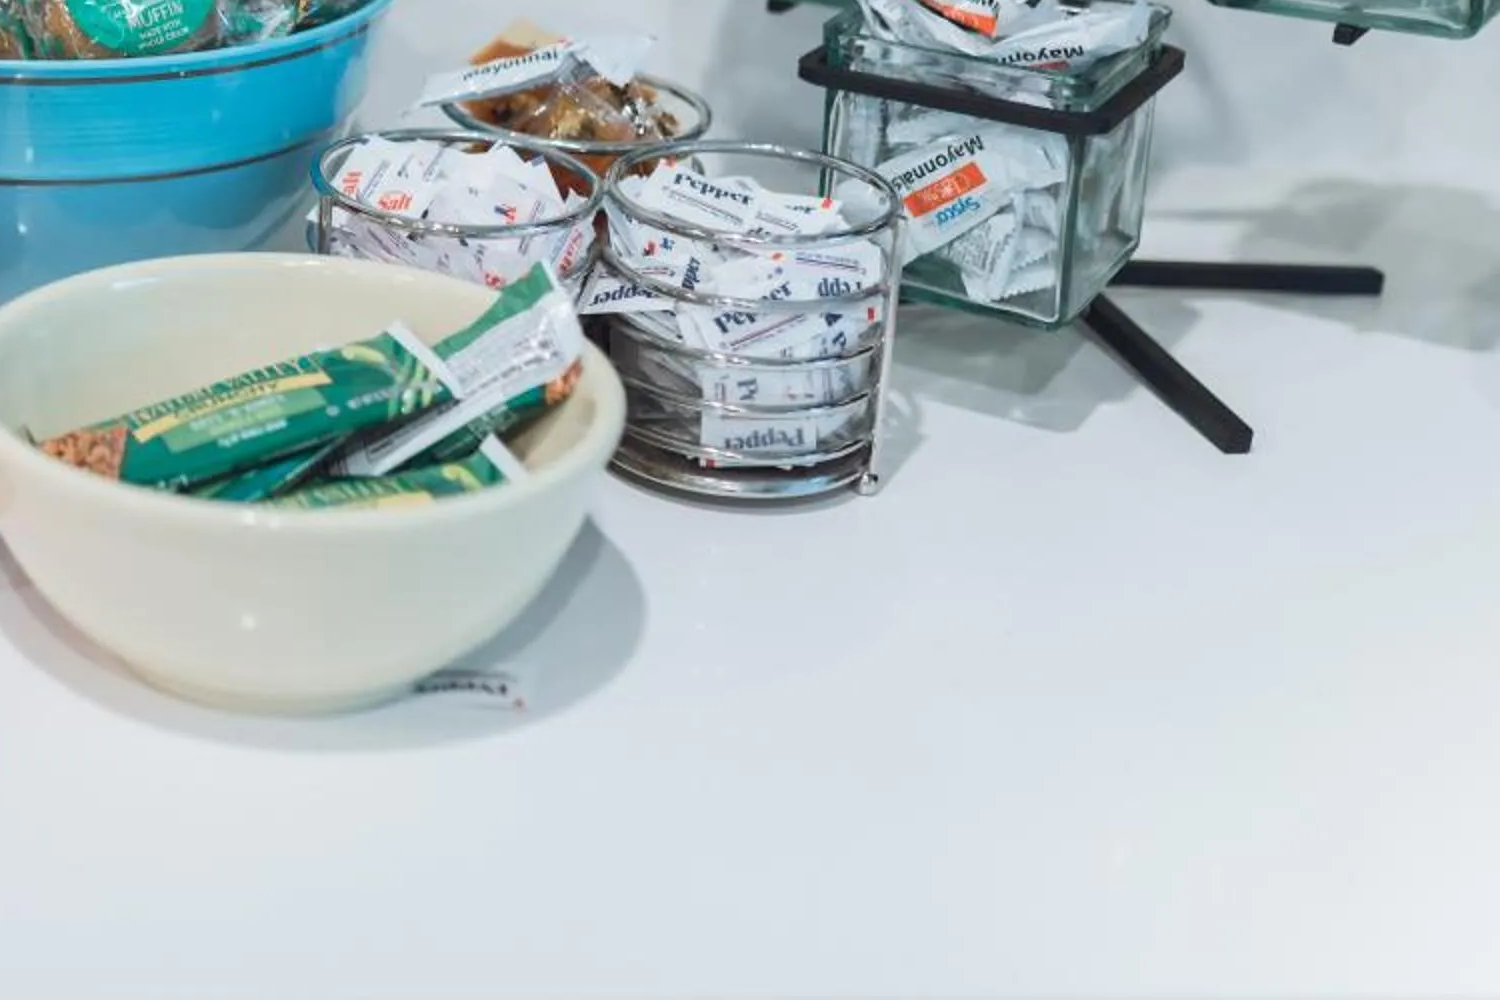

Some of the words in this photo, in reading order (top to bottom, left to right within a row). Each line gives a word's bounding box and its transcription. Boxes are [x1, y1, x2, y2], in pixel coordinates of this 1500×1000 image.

[673, 172, 753, 206] Pepper
[376, 193, 414, 212] Salt
[724, 426, 805, 451] Pepper
